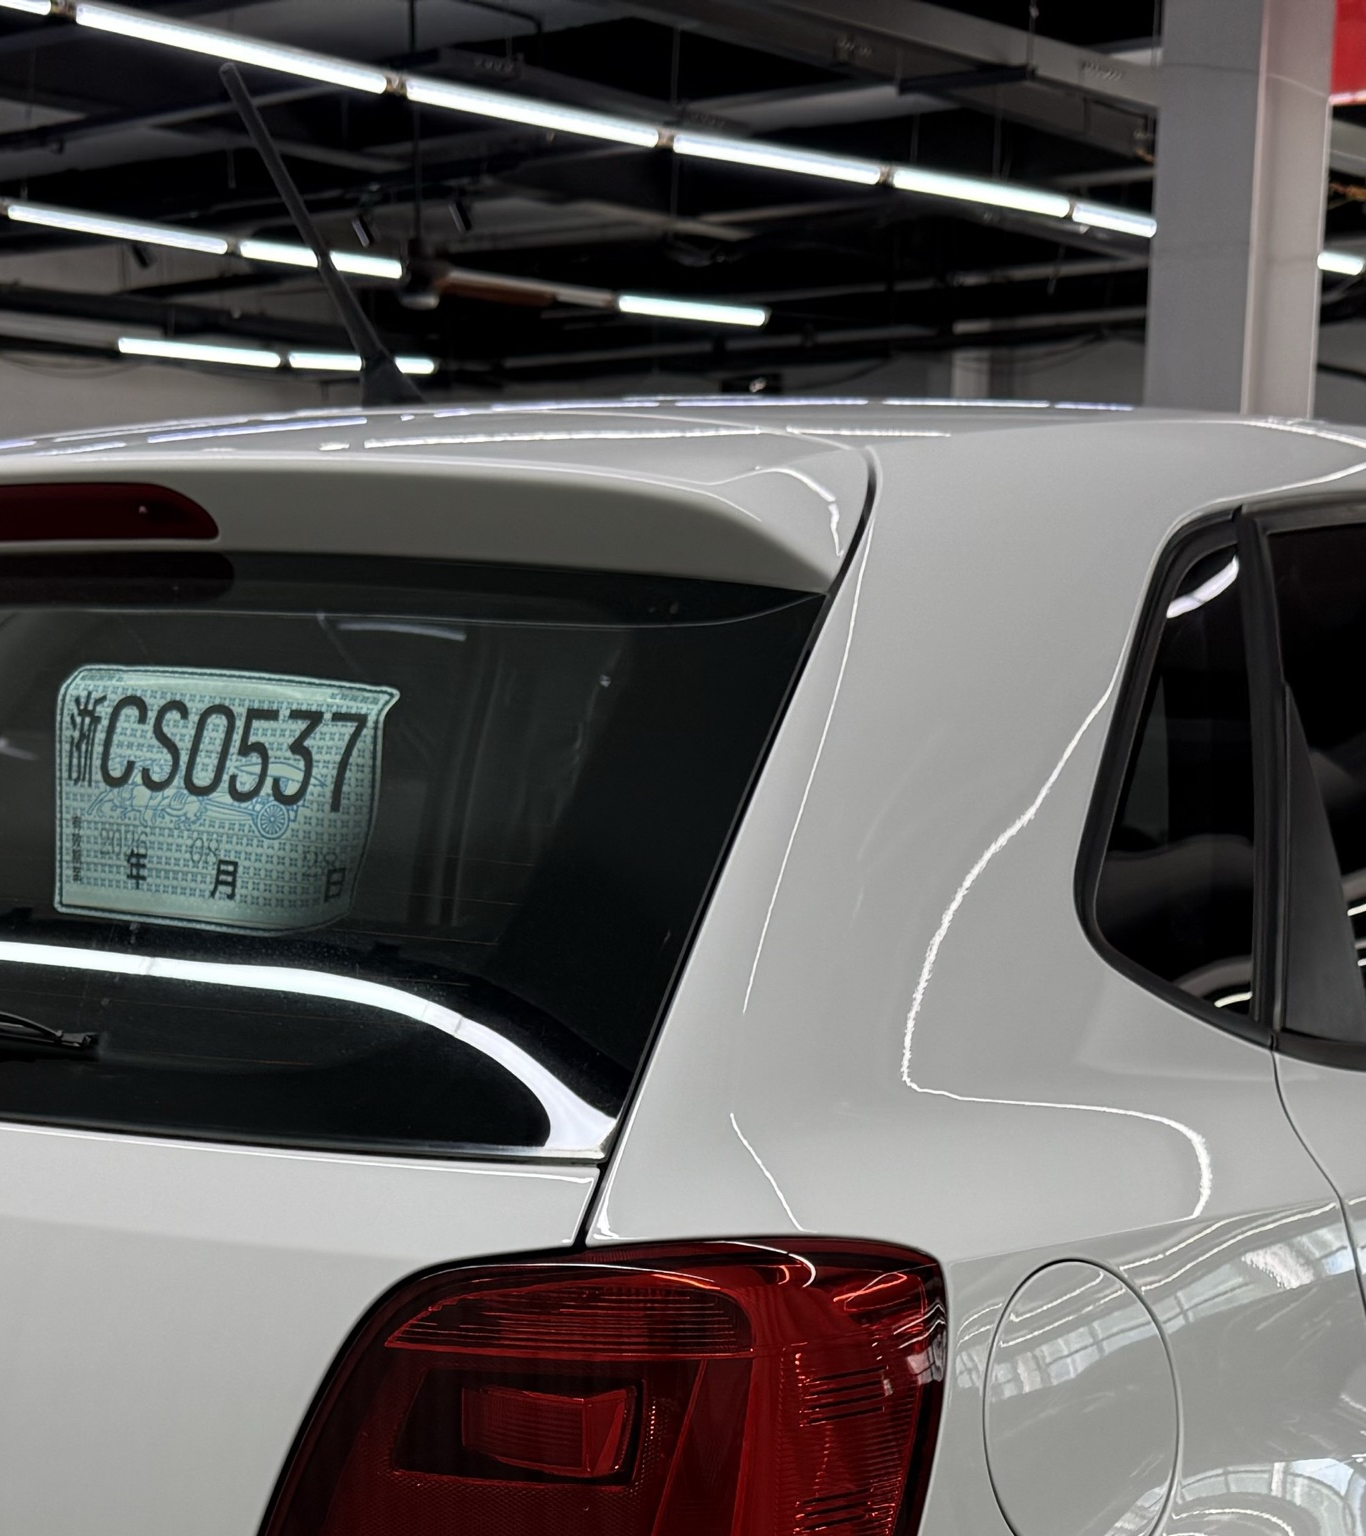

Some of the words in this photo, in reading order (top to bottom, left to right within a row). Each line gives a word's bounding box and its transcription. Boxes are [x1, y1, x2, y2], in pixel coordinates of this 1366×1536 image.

[68, 691, 369, 813] 浙CS0537
[126, 848, 147, 890] 年
[209, 859, 238, 900] 月
[325, 867, 347, 902] 日
